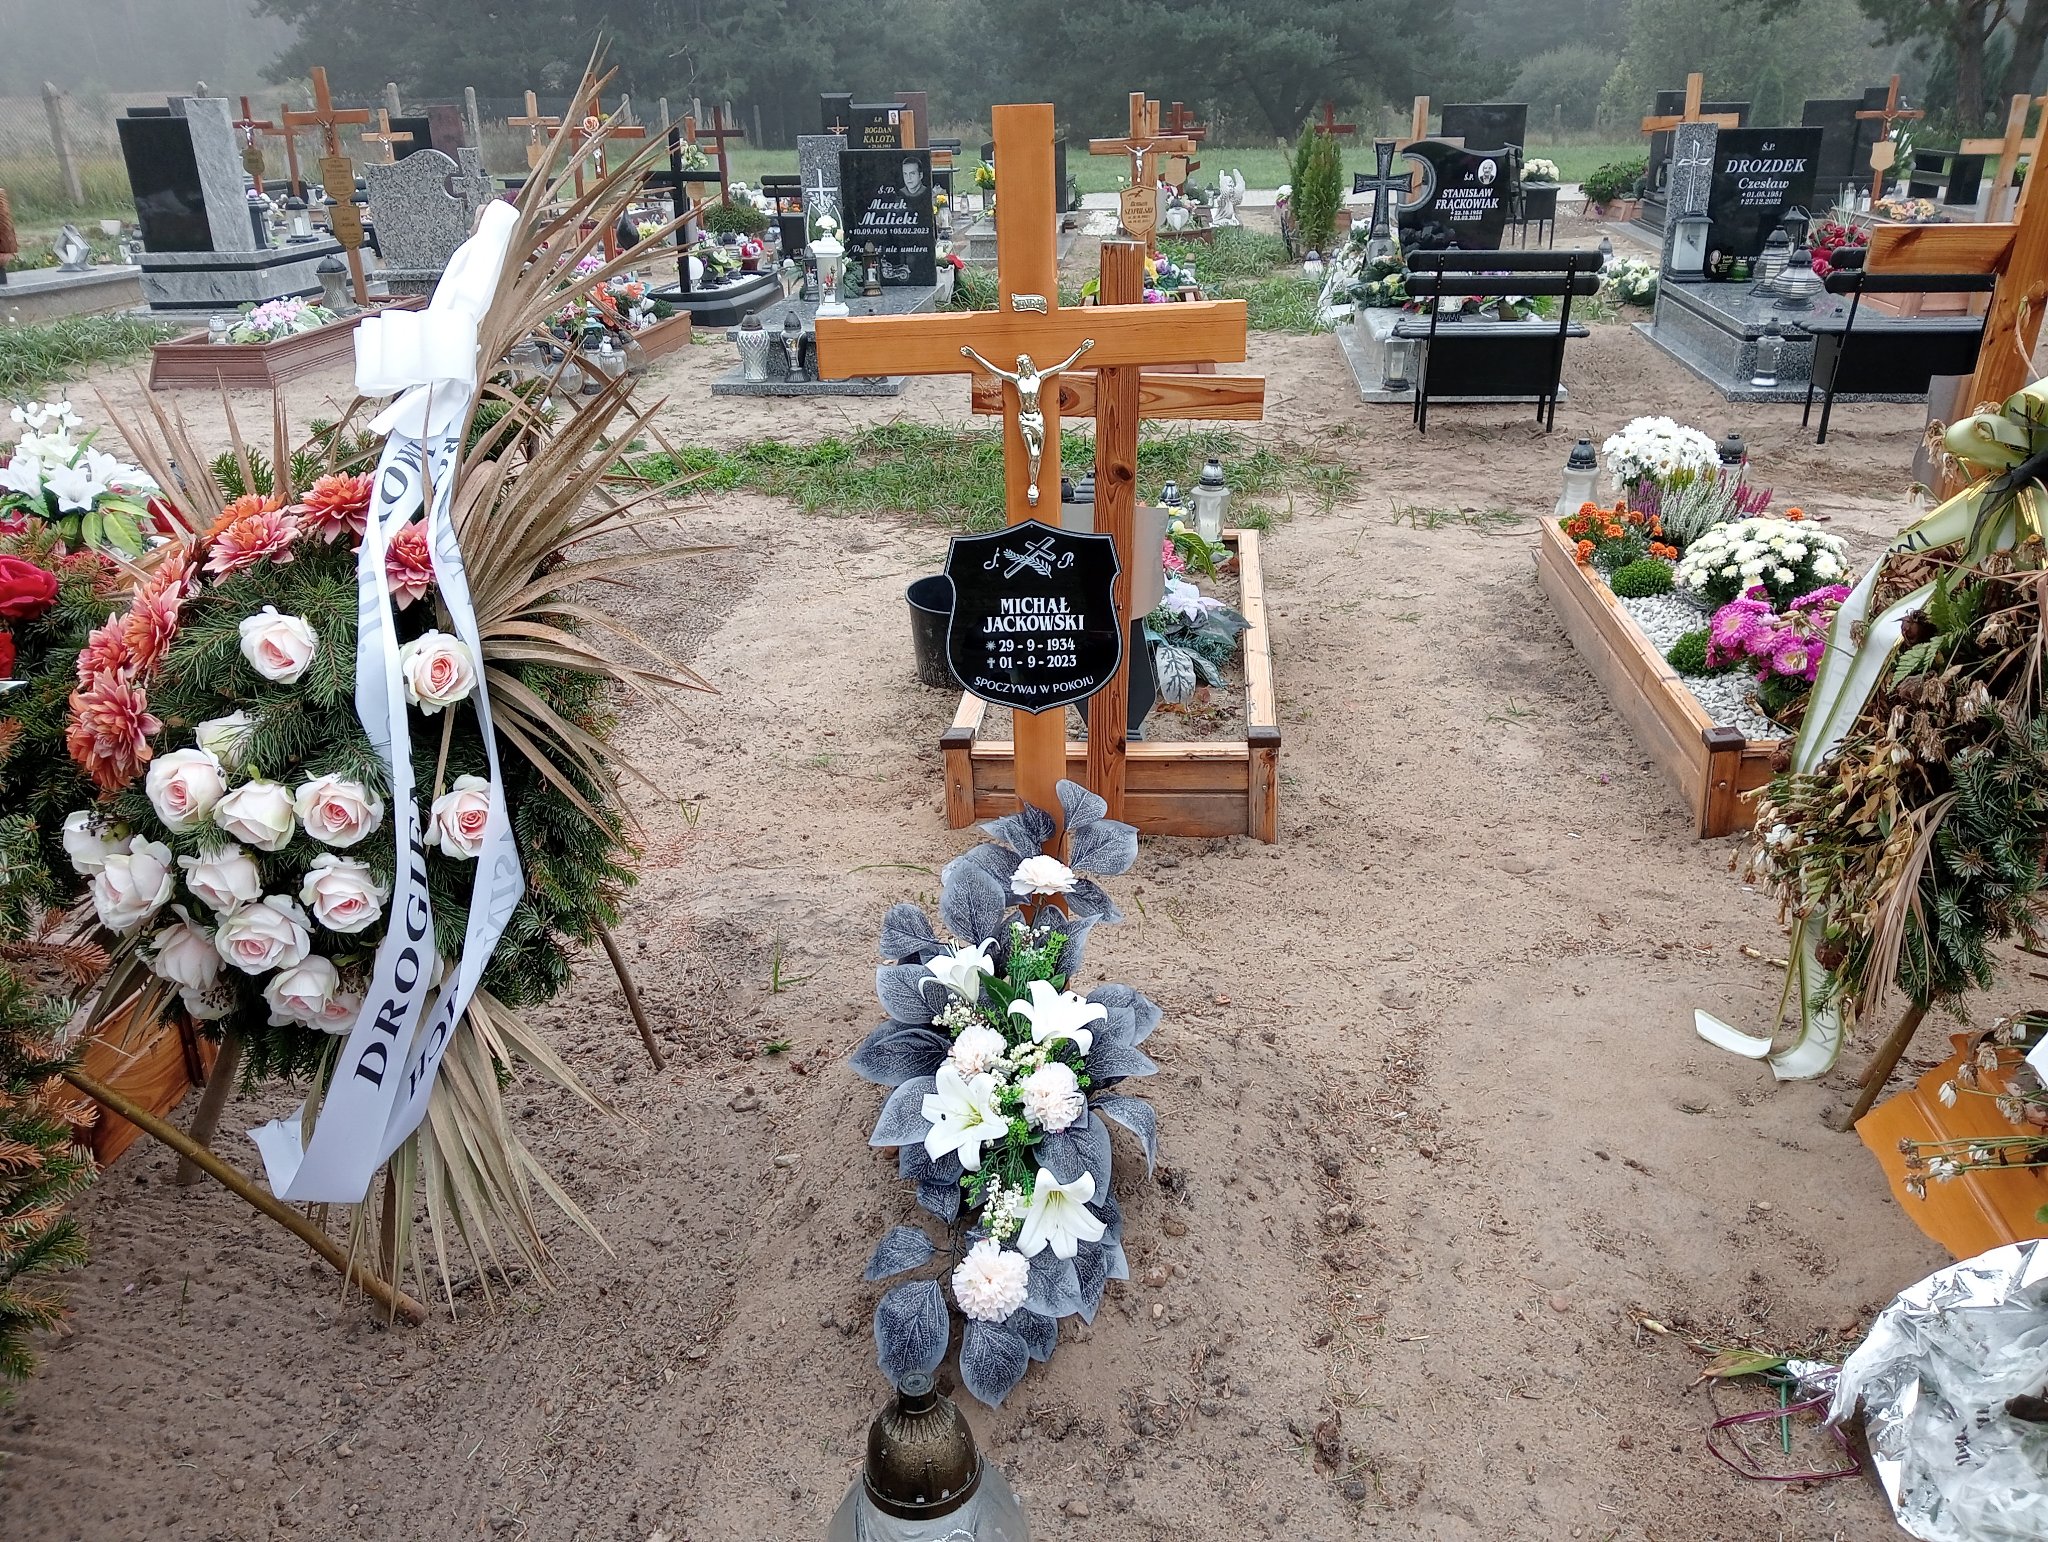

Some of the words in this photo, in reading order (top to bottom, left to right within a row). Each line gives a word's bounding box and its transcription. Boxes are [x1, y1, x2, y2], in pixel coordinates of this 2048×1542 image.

[864, 126, 892, 134] BOGDAN
[863, 135, 895, 143] KALOTA
[1762, 142, 1775, 151] Ś.P.
[1725, 159, 1807, 173] DROZDEK
[1463, 171, 1474, 181] Ś.P.
[1738, 177, 1789, 189] Czesław
[1442, 188, 1493, 198] STANISŁAW
[867, 199, 908, 210] Marek
[1435, 198, 1500, 211] FRĄCKOWIAK
[858, 211, 919, 226] Malicki
[1000, 597, 1070, 615] MICHAŁ
[982, 614, 1085, 633] JACKOWSKI
[1047, 637, 1075, 651] 1934
[1047, 655, 1077, 668] 2023
[974, 676, 1037, 695] SPOCZYWAJ
[1039, 685, 1050, 694] W
[1053, 675, 1095, 693] POKOJU
